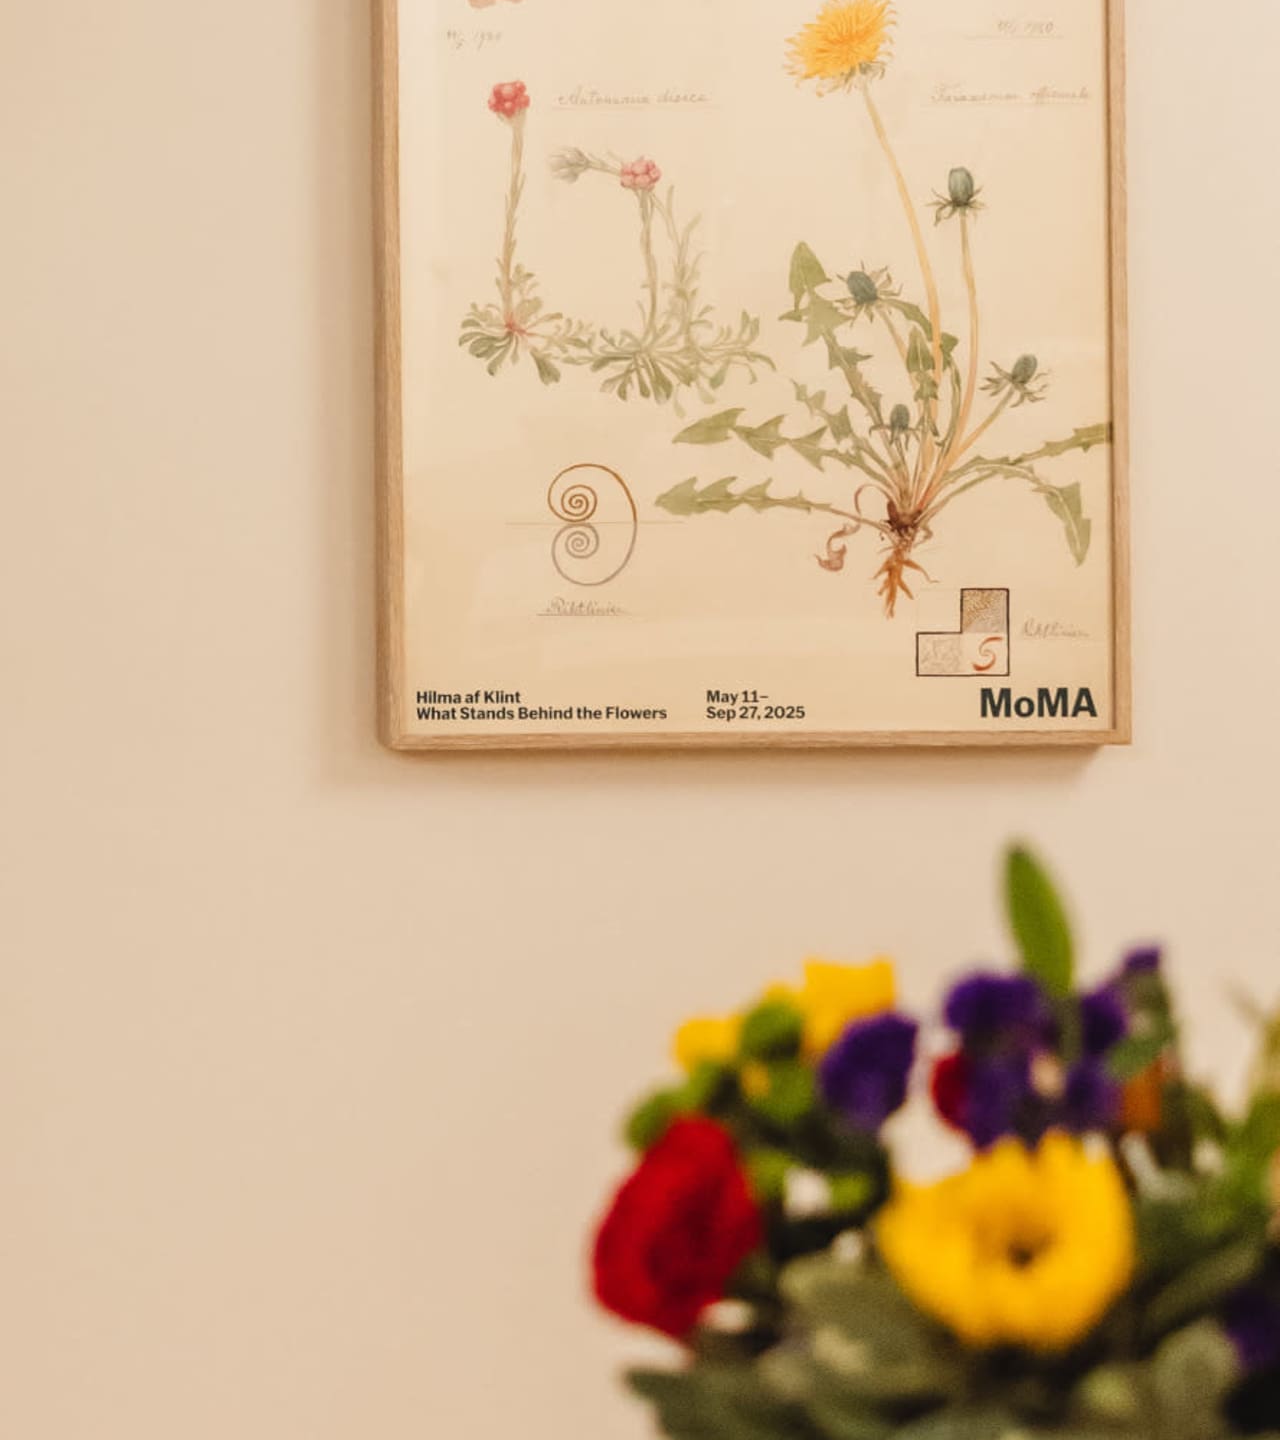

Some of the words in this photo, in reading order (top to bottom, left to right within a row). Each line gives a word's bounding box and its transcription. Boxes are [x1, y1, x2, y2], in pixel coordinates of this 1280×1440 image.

[416, 690, 462, 704] Hilma
[464, 689, 481, 704] af
[483, 689, 521, 704] Klint
[706, 689, 739, 706] May
[980, 687, 1098, 718] MoMA
[416, 706, 457, 720] What
[459, 706, 515, 720] Stands
[517, 706, 574, 720] Behind
[576, 706, 603, 720] the
[605, 706, 668, 720] Flowers
[706, 705, 737, 722] Sep
[738, 705, 761, 722] 27,
[763, 705, 806, 720] 2025
